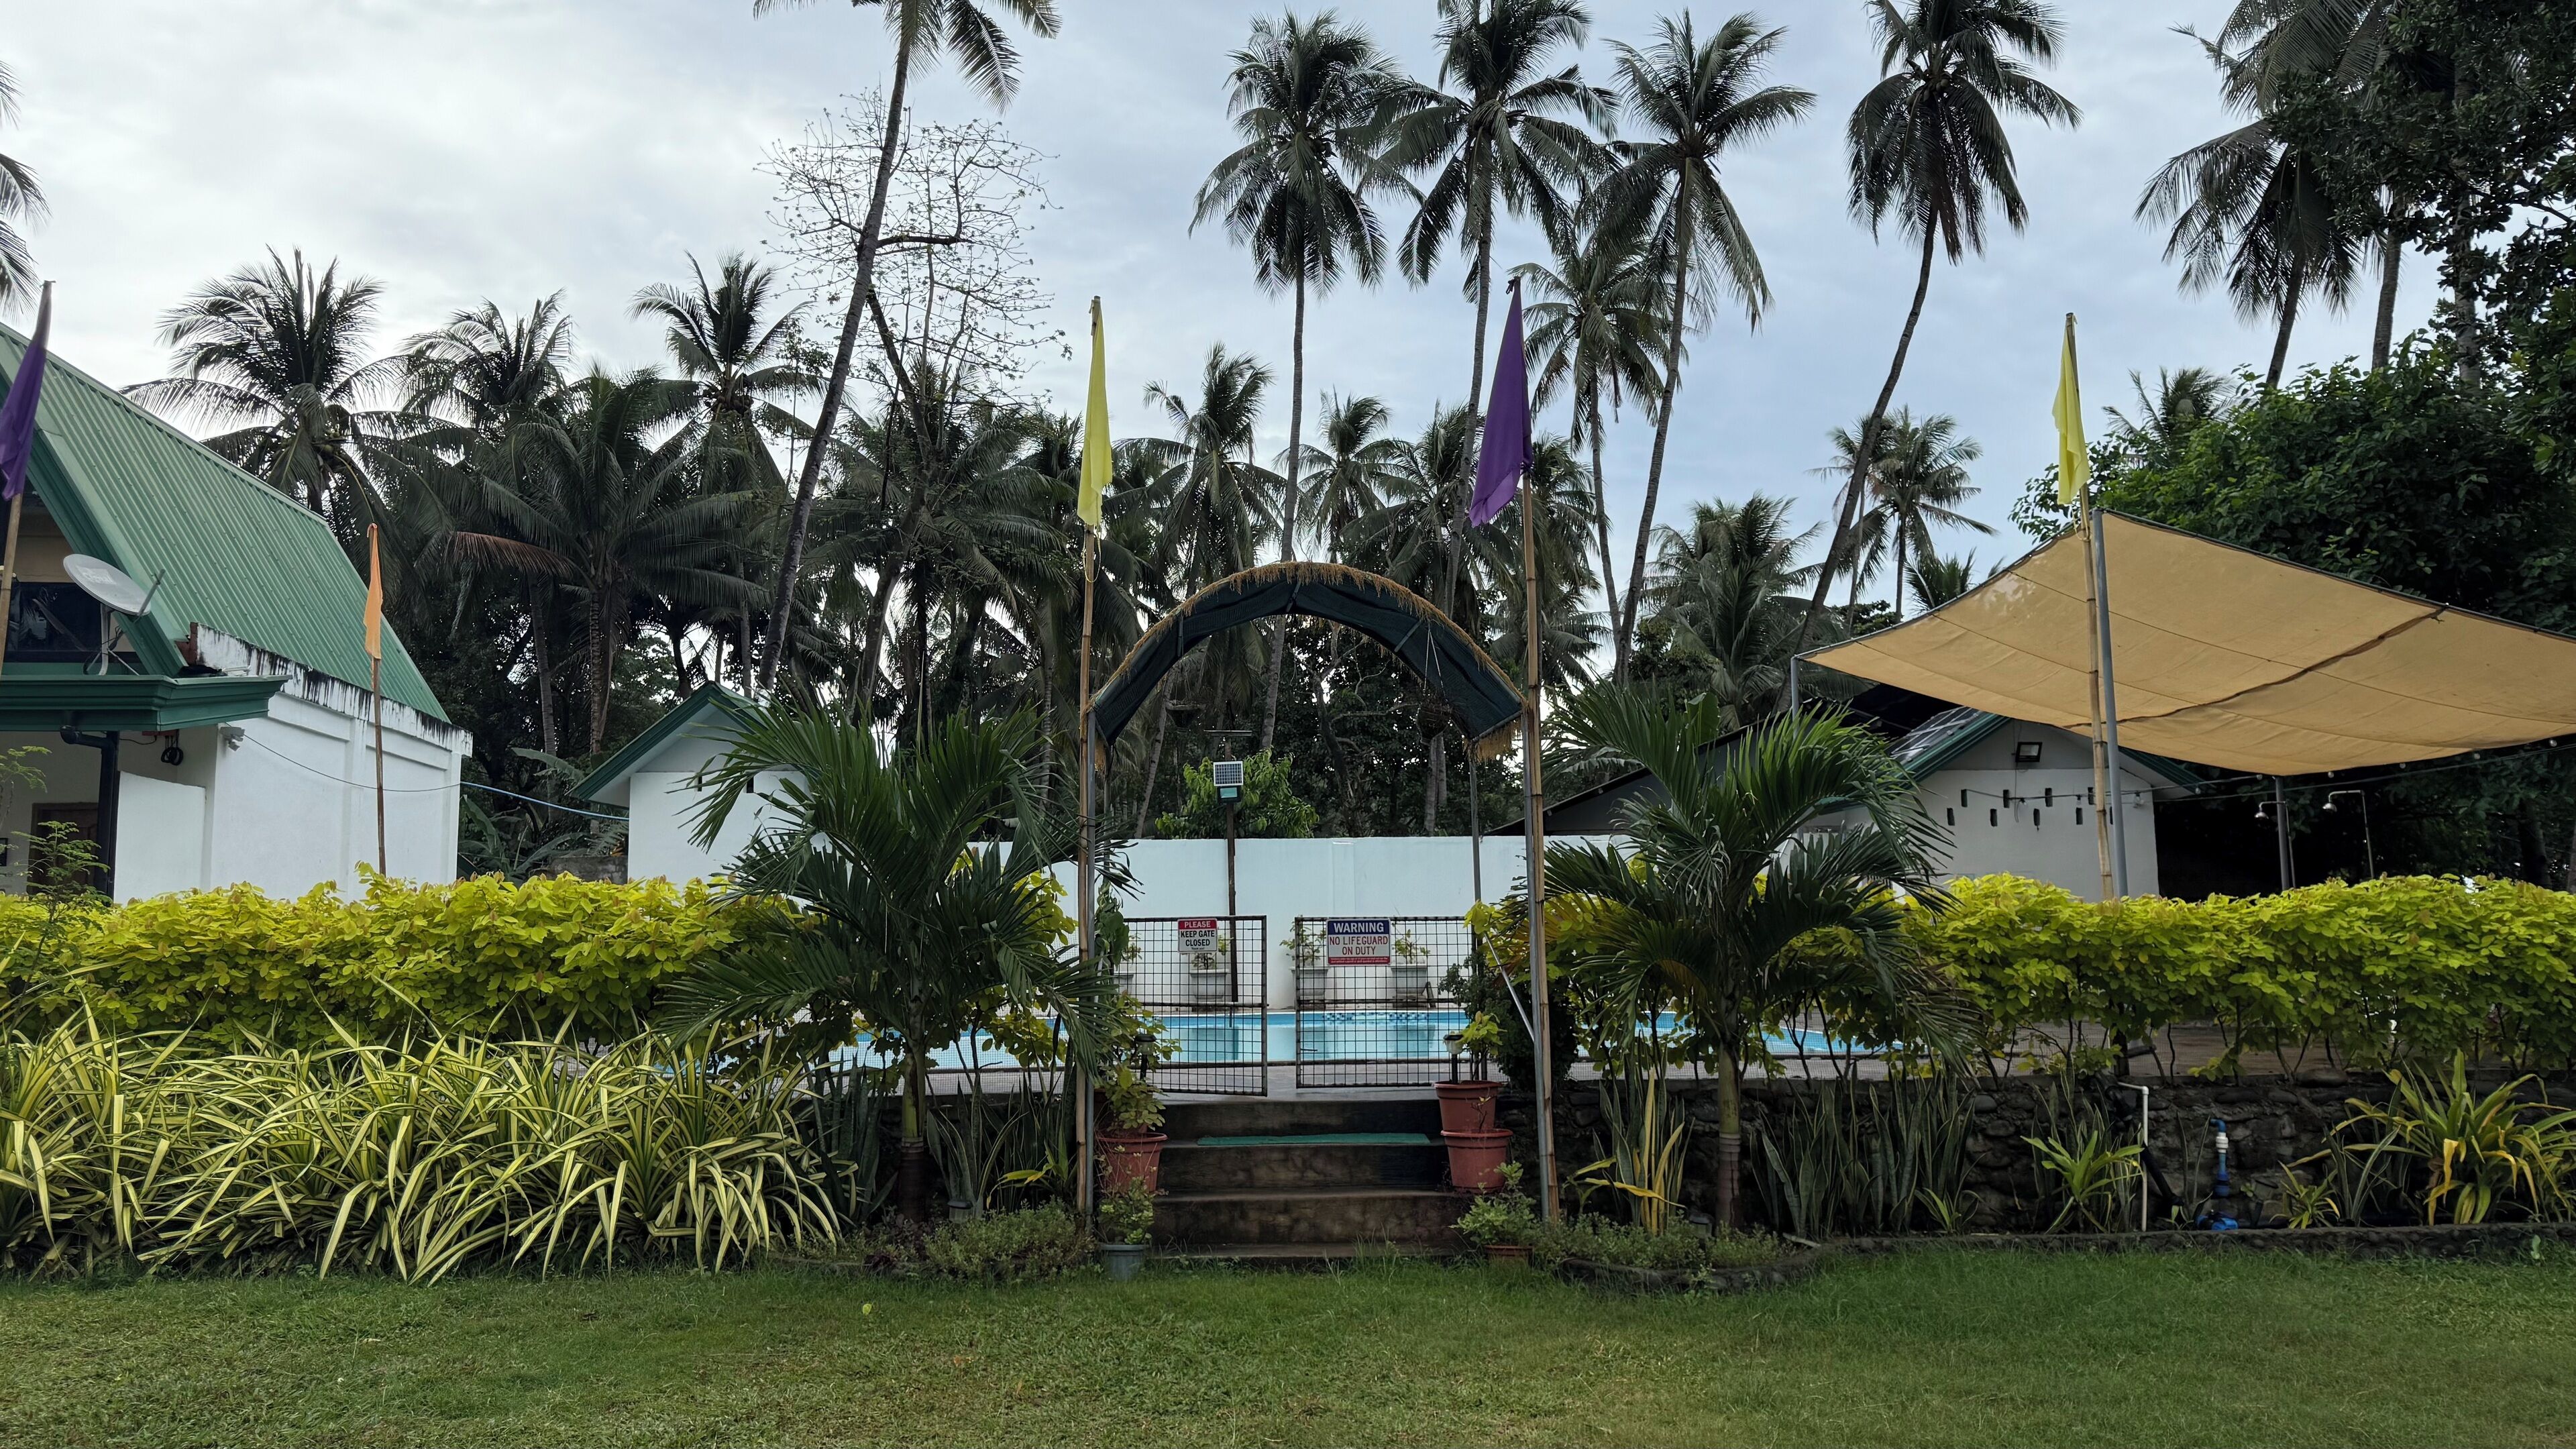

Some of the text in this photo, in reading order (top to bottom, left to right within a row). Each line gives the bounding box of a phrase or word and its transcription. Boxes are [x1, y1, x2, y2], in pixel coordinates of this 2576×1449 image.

[1334, 922, 1384, 933] WARNING
[1330, 936, 1388, 945] NO LIFEGUARD
[1342, 946, 1376, 955] ON DUTY
